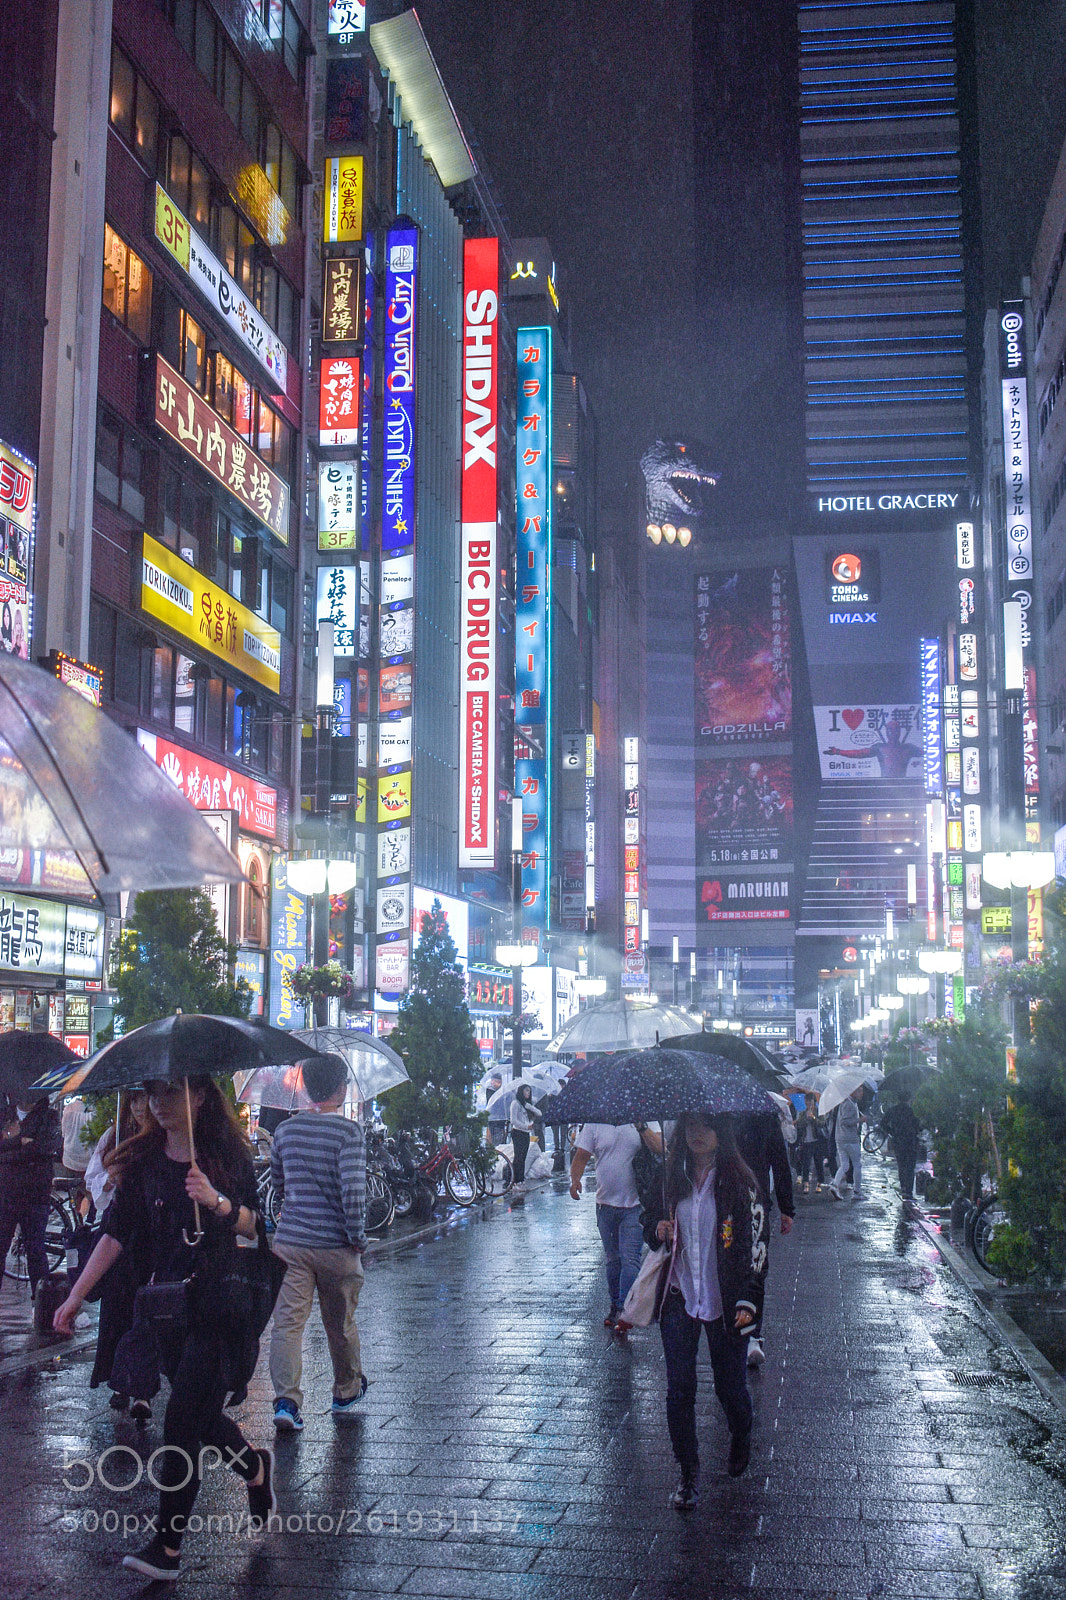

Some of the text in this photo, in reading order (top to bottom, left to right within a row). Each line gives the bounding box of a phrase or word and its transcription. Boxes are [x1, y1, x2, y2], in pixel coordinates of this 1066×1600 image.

[339, 33, 354, 44] 8F
[341, 168, 357, 230] 鳥貴族
[163, 204, 184, 252] 3F
[329, 261, 353, 329] 山内農場
[334, 329, 347, 339] 5F
[387, 275, 413, 392] Plain City
[1001, 312, 1023, 368] Booth
[159, 374, 177, 417] 5F
[339, 373, 355, 415] 焼肉屋
[464, 289, 498, 470] SHIDAX
[323, 379, 340, 426] さかい
[1009, 385, 1022, 450] ネットカフェ
[178, 391, 273, 520] 山内農場
[330, 431, 348, 444] 4F
[819, 494, 959, 511] HOTEL GRACERY
[1012, 471, 1025, 516] カプセル
[328, 533, 347, 546] 3F
[961, 531, 970, 565] 東京ビル
[144, 562, 189, 609] TORIKIZOKU
[832, 585, 858, 594] TOHO
[832, 594, 869, 602] CINEMAS
[200, 592, 238, 656] 鳥貴族
[467, 540, 490, 681] BIC DRUG
[829, 612, 877, 624] IMAX
[244, 633, 277, 668] TORIKIZOKU
[472, 695, 483, 718] BIC
[701, 722, 786, 735] GODZILLA
[829, 709, 841, 732] I
[925, 645, 941, 787] 747 カラオケランド
[471, 722, 483, 777] CAMERA
[186, 766, 220, 810] 焼肉屋
[220, 770, 254, 820] さかい
[255, 808, 275, 829] SAKAI
[470, 785, 483, 843] SHIDAX
[727, 881, 789, 899] MARUHAN
[284, 892, 305, 949] Miami
